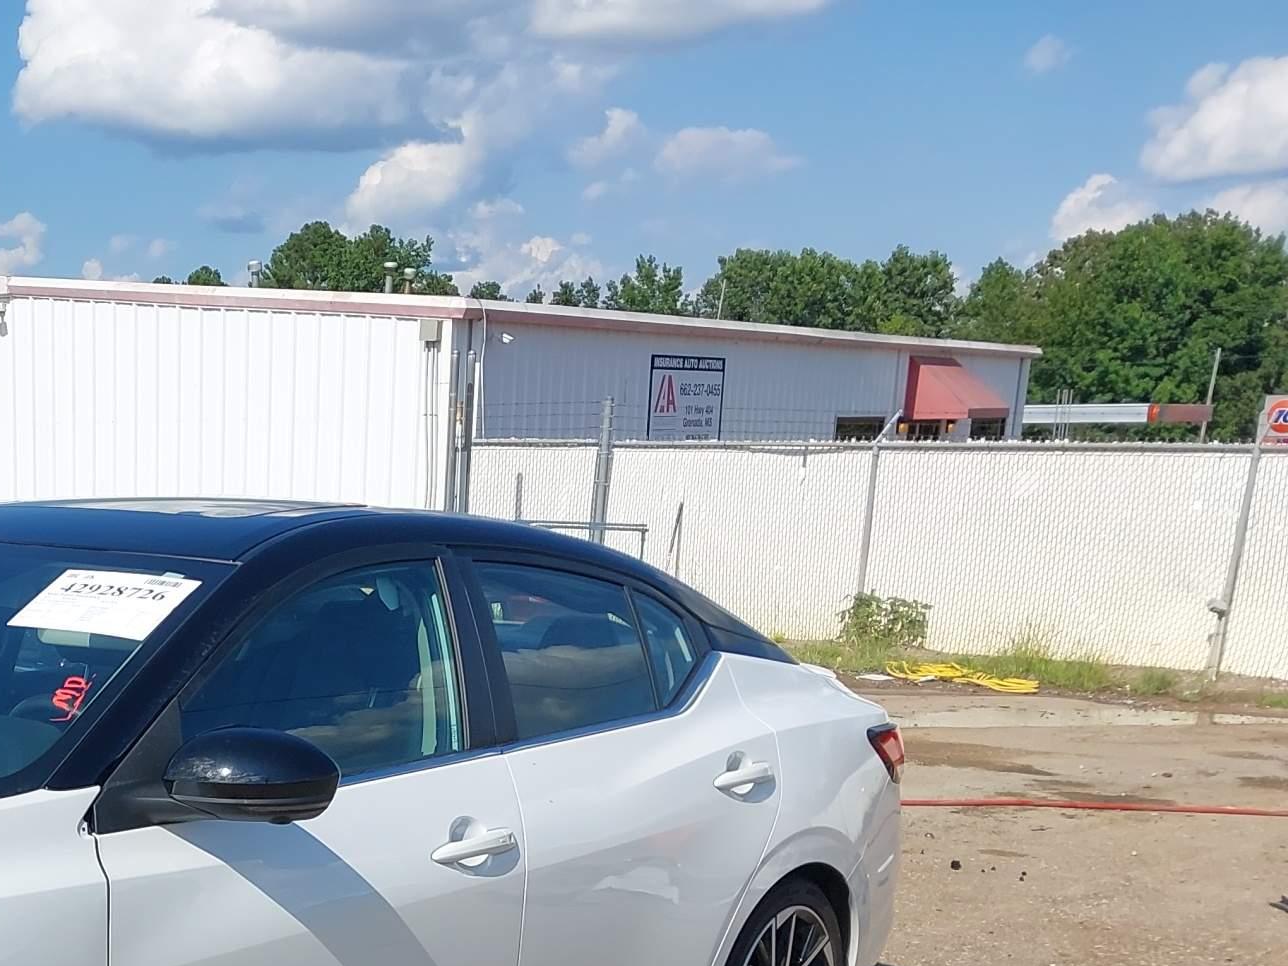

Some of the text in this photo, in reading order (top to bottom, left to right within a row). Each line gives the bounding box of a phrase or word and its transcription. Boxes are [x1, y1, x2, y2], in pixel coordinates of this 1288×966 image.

[653, 356, 723, 370] INSURANCE AUTO AUCTIONS
[60, 582, 169, 601] 42928726
